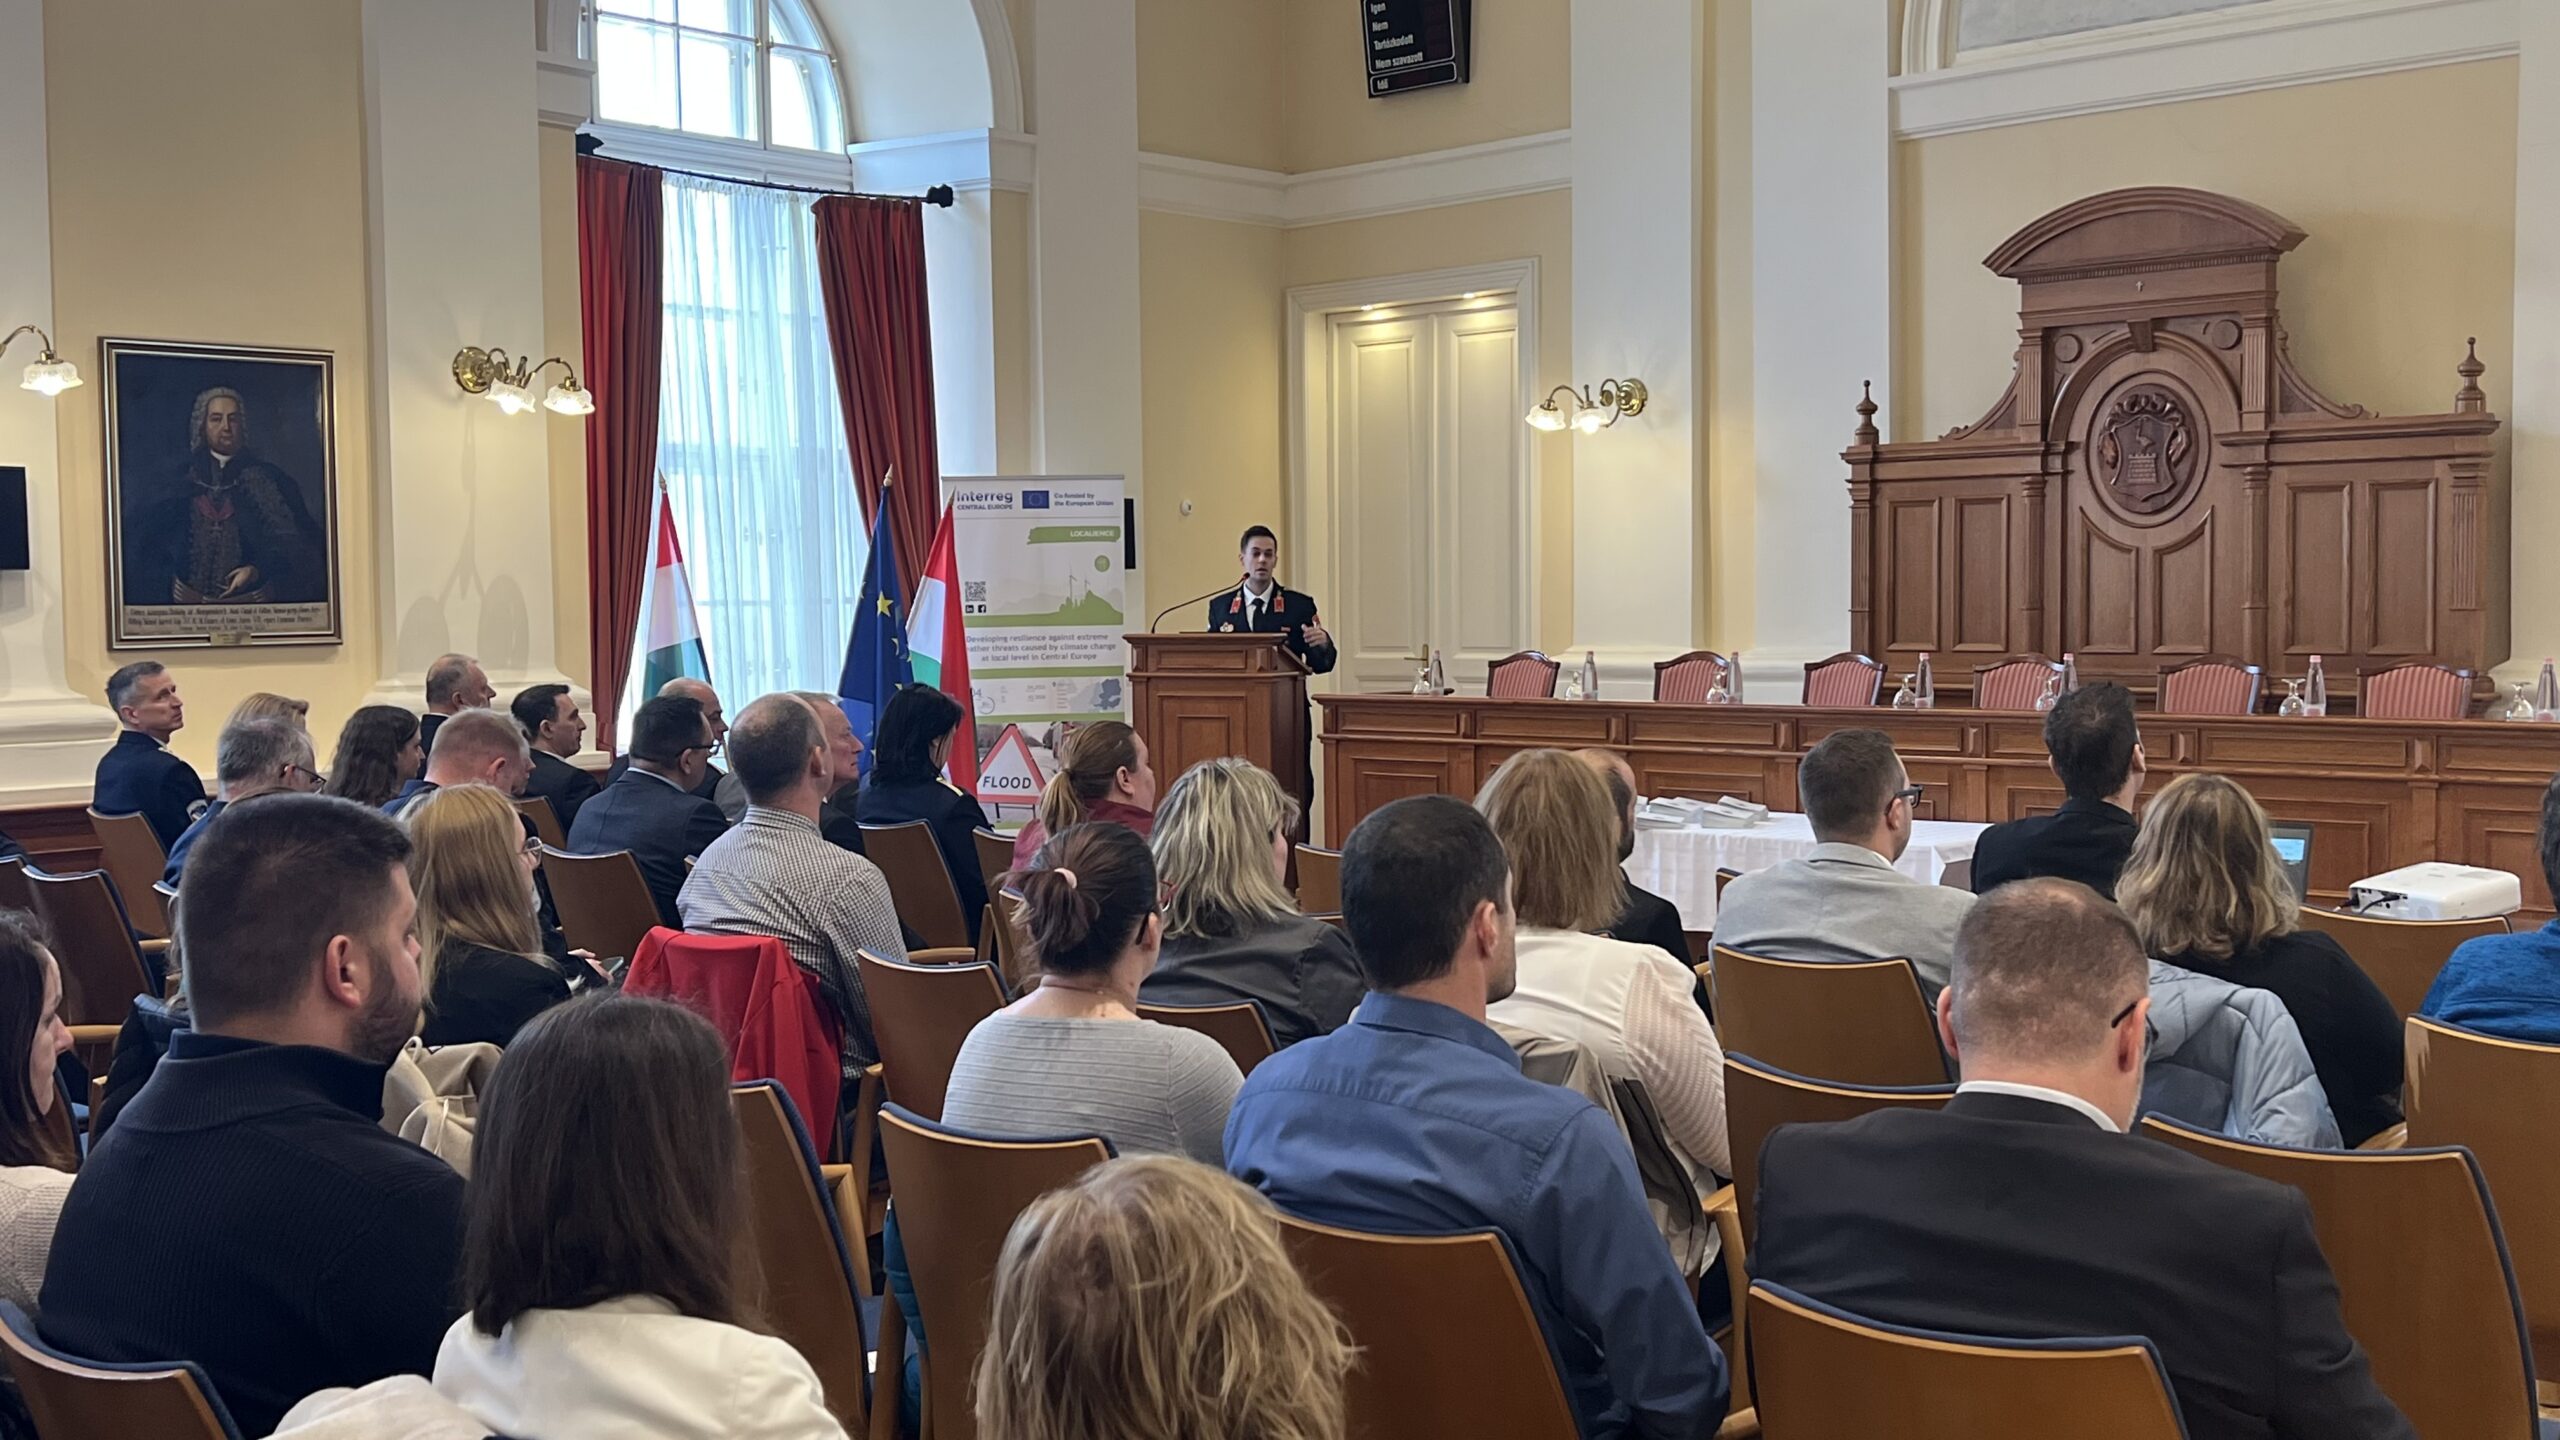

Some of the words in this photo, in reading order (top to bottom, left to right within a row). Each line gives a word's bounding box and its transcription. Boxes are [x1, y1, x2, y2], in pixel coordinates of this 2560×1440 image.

[1370, 2, 1386, 15] Igen
[1372, 21, 1388, 32] Nem
[1376, 59, 1392, 70] Nem
[1088, 492, 1094, 501] by
[1049, 634, 1074, 642] against
[1049, 644, 1058, 652] by
[1041, 652, 1068, 660] Central
[1071, 652, 1097, 660] Europe
[982, 776, 1032, 789] FLOOD
